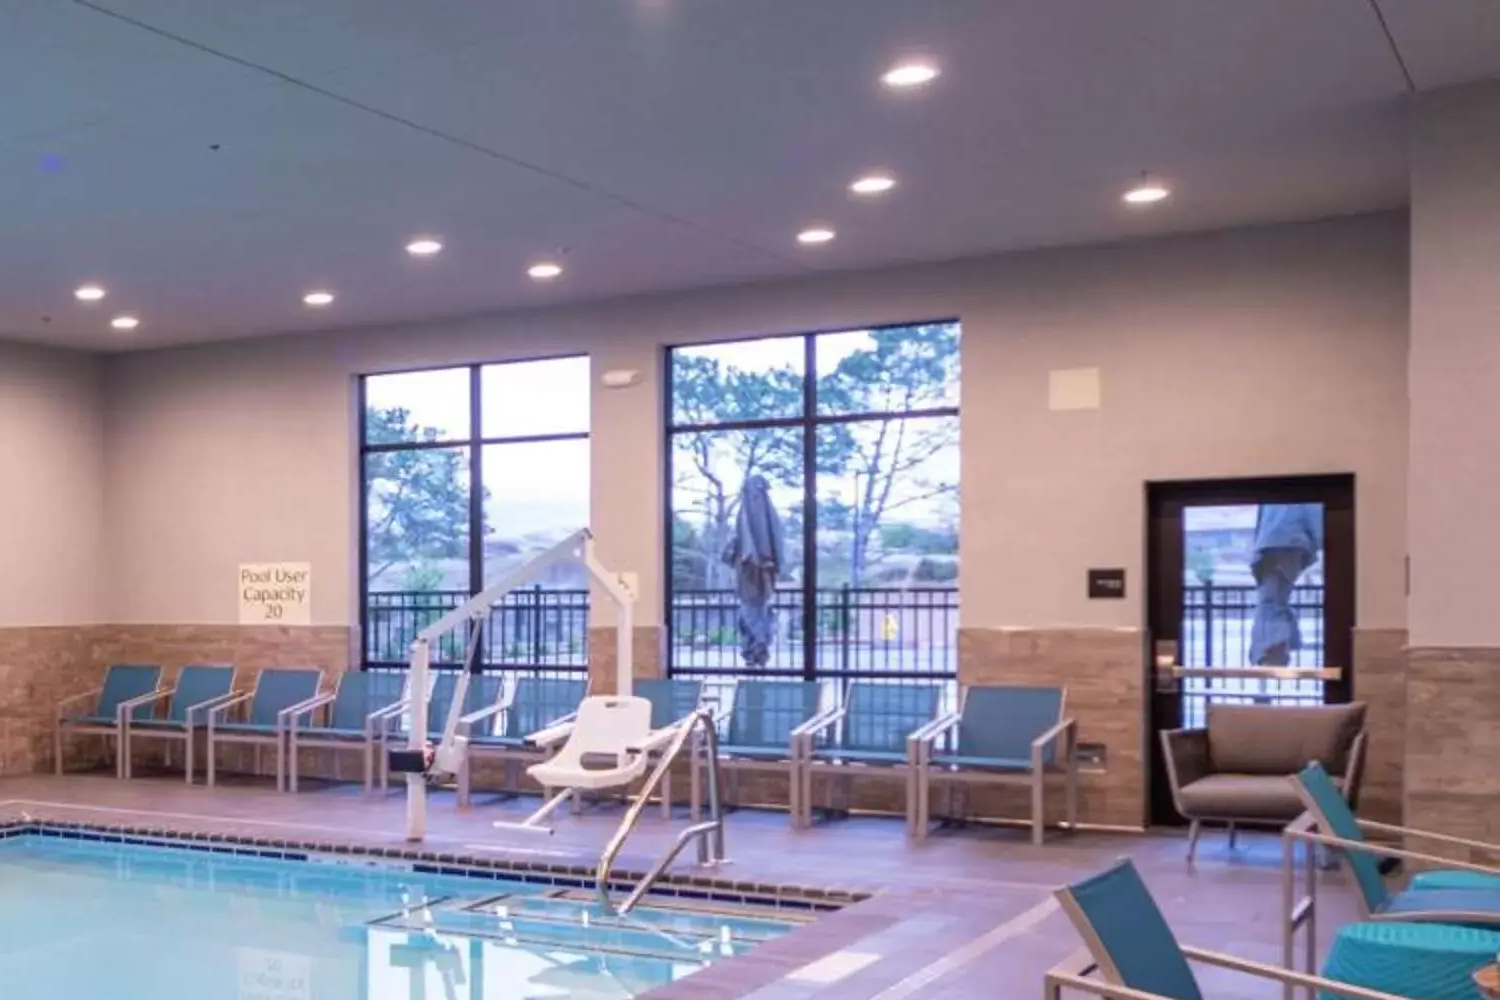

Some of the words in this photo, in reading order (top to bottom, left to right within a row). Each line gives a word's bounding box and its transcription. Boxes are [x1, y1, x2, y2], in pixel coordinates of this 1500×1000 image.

[241, 568, 271, 584] Pool
[275, 568, 308, 583] User
[243, 587, 305, 604] Capacity
[265, 603, 283, 619] 20
